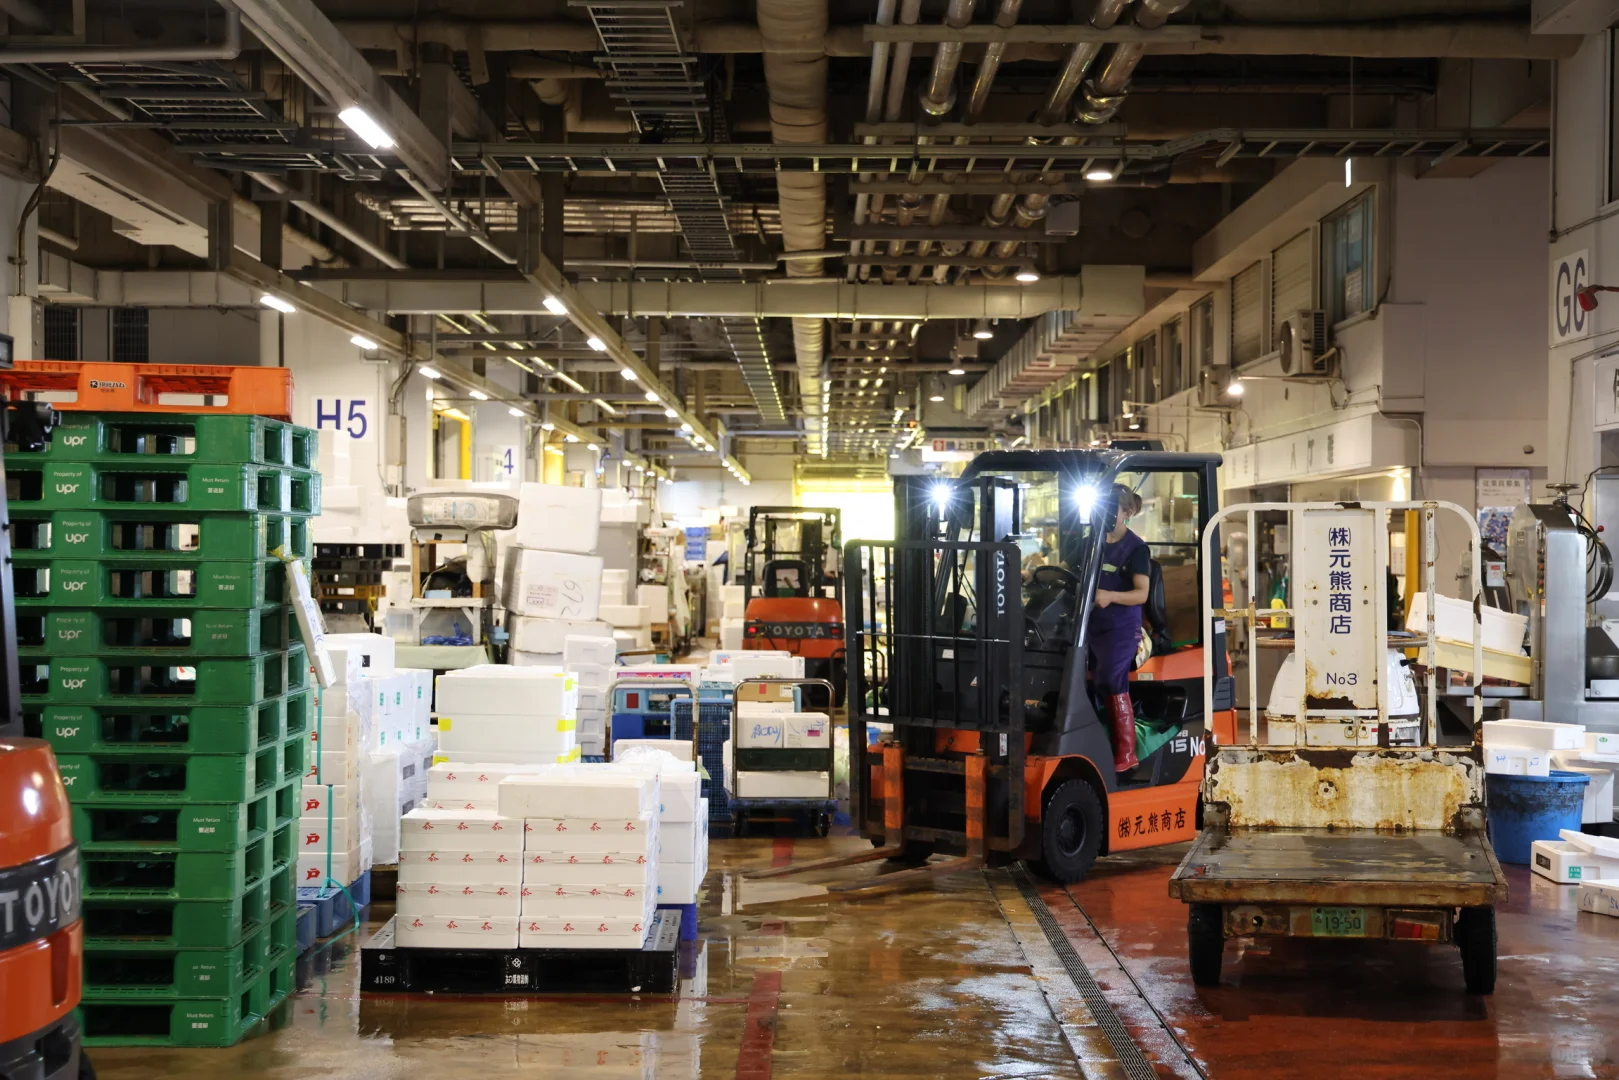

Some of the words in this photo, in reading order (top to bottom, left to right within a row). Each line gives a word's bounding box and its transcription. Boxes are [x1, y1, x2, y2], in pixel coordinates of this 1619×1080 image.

[1556, 257, 1586, 337] G6
[316, 398, 368, 440] H5
[64, 436, 88, 446] upr
[56, 484, 80, 494] upr
[65, 534, 89, 544] upr
[63, 582, 87, 592] upr
[996, 550, 1005, 618] TOYOTA
[58, 630, 82, 641] upr
[62, 678, 86, 690] upr
[1326, 672, 1358, 686] No3
[56, 727, 80, 738] upr
[1170, 738, 1187, 753] 15
[64, 776, 77, 788] pr
[374, 976, 395, 984] 4189
